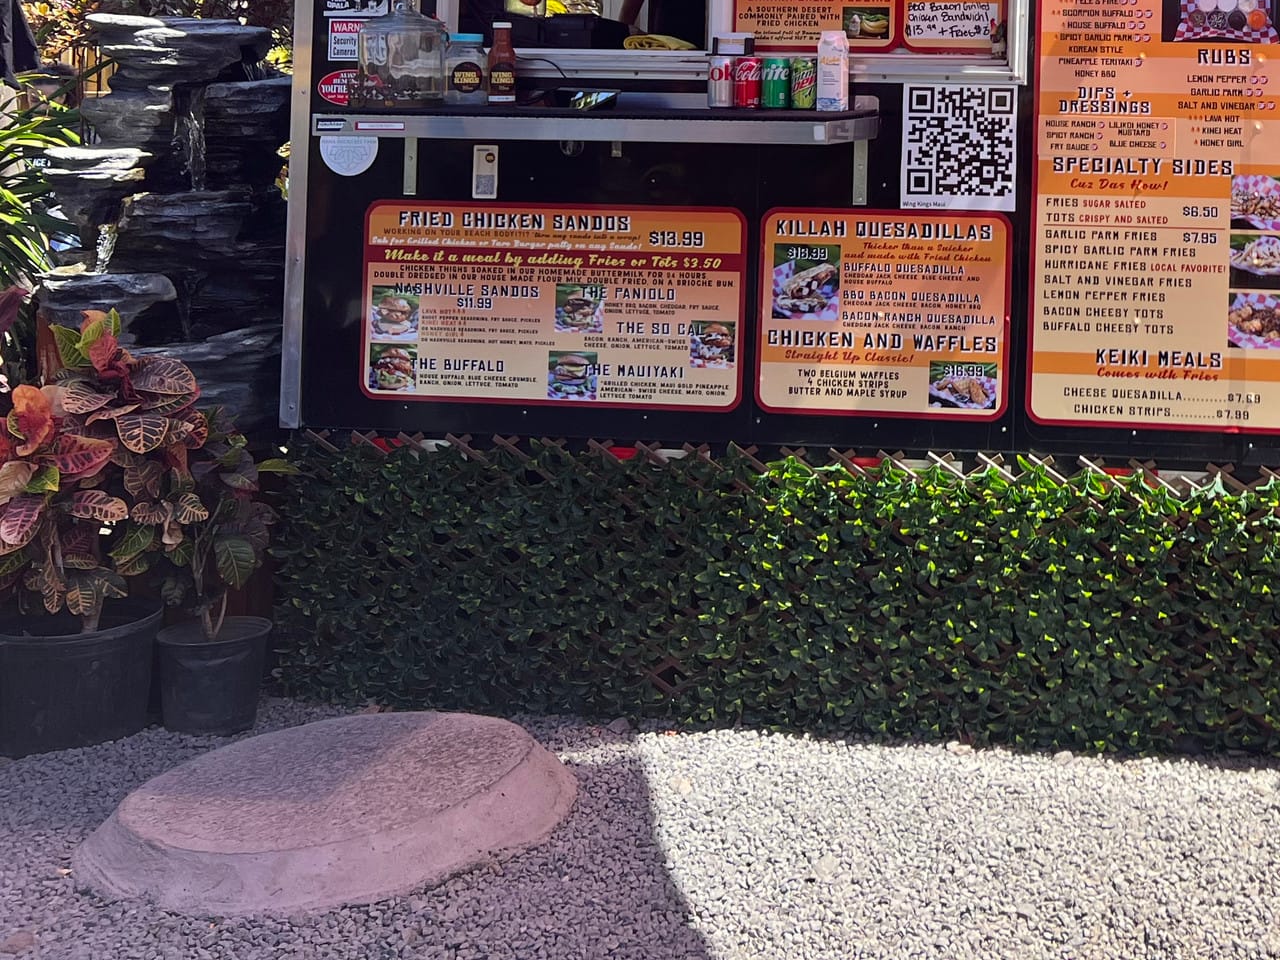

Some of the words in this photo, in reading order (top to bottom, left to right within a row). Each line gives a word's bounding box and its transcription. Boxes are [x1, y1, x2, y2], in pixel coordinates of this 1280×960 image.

[1062, 9, 1099, 18] SCORPION
[1102, 9, 1134, 18] BUFFALO
[1068, 45, 1098, 54] KOREAN
[1100, 45, 1124, 54] STYLE
[1197, 48, 1252, 66] RUBS
[1187, 74, 1213, 83] LEMON
[1216, 75, 1247, 84] PEPPER
[1077, 86, 1117, 100] DIPS
[1058, 100, 1152, 115] DRESSINGS
[1178, 101, 1198, 110] SALT
[1201, 101, 1218, 110] AND
[1220, 102, 1255, 111] VINEGAR
[1053, 156, 1163, 176] SPECIALTY
[1171, 158, 1233, 178] SIDES
[1070, 178, 1094, 191] Cuz
[1098, 178, 1126, 191] Das
[1046, 198, 1079, 208] FRIES
[1082, 199, 1111, 208] SUGAR
[1114, 199, 1147, 209] SALTED
[1182, 205, 1219, 219] $6.50
[1045, 212, 1076, 223] TOTS
[1078, 214, 1111, 223] CRISPY
[1113, 214, 1134, 224] AND
[1136, 215, 1169, 225] SALTED
[399, 211, 455, 228] FRIED
[462, 212, 546, 231] CHICKEN
[552, 214, 632, 233] SANDOS
[649, 230, 706, 249] $13.99
[776, 219, 848, 238] KILLAH
[855, 221, 994, 242] QUESADILLAS
[1045, 229, 1087, 240] GARLIC
[1090, 230, 1120, 241] PARM
[1124, 231, 1158, 242] FRIES
[1182, 232, 1218, 245] $7.95
[384, 248, 431, 261] Make
[432, 250, 445, 262] it
[448, 252, 460, 262] a
[462, 251, 502, 263] meal
[505, 251, 525, 268] by
[528, 252, 584, 270] adding
[588, 253, 627, 268] Fries
[630, 256, 648, 268] or
[651, 255, 679, 269] Tots
[683, 257, 723, 270] $3.50
[1044, 259, 1109, 271] HURRICANE
[1112, 260, 1147, 271] FRIES
[1150, 263, 1177, 272] LOCAL
[844, 262, 893, 273] BUFFALO
[895, 264, 965, 276] QUESADILLA
[395, 282, 476, 297] NASHVILLE
[480, 285, 542, 300] SANDOS
[581, 285, 609, 300] THE
[614, 287, 678, 302] PANIOLO
[456, 297, 494, 311] $11.99
[767, 329, 856, 351] CHICKEN
[862, 332, 904, 351] AND
[911, 334, 998, 354] WAFFLES
[784, 348, 840, 361] Straight
[842, 350, 862, 364] Up
[864, 351, 916, 364] Classic!
[1096, 348, 1150, 369] KEIKI
[1157, 351, 1223, 373] MEALS
[583, 363, 611, 377] THE
[617, 364, 686, 379] MAUIYAKI
[1096, 367, 1140, 380] Comes
[1143, 367, 1178, 380] with
[1181, 369, 1220, 382] Fries
[788, 386, 822, 397] BUTTER
[824, 387, 844, 397] AND
[846, 387, 878, 398] MAPLE
[880, 388, 908, 400] SYRUP
